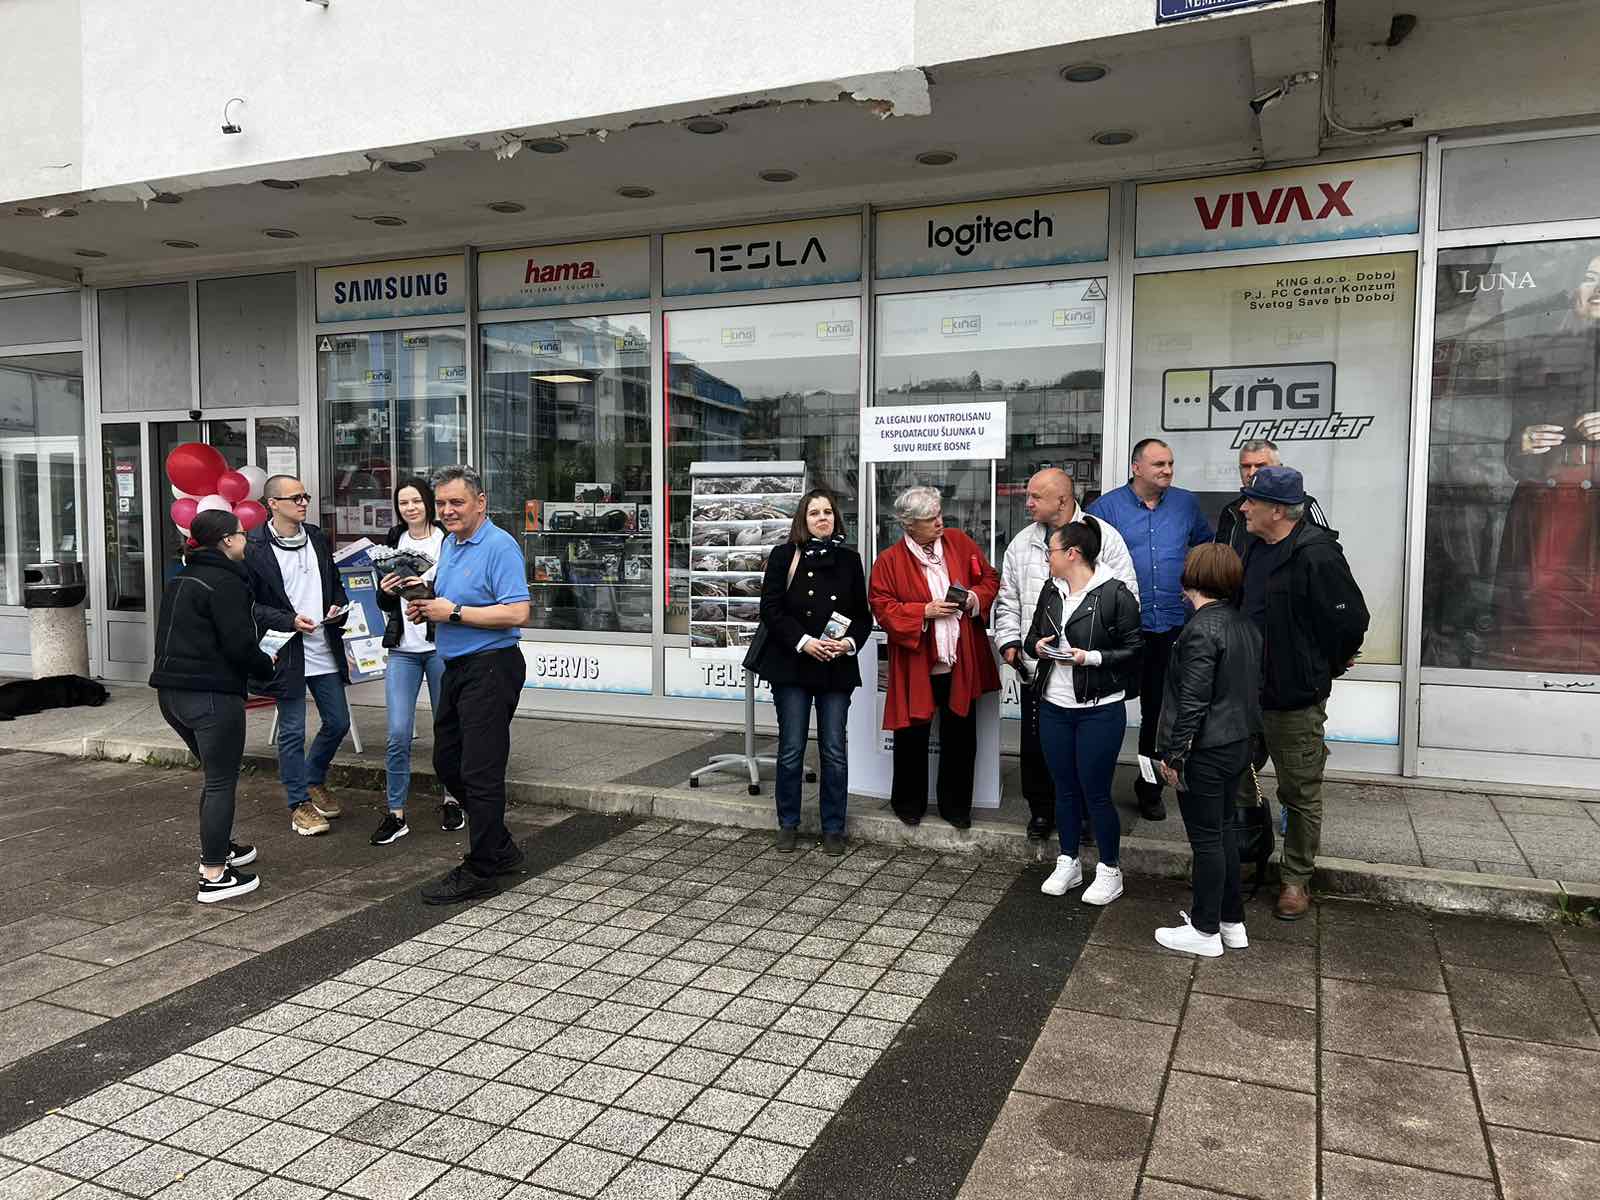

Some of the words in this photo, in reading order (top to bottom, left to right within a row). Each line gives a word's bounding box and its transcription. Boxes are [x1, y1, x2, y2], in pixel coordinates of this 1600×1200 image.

[1193, 179, 1354, 230] VIVAX
[928, 209, 1054, 256] logitech
[695, 237, 827, 272] TESLA
[525, 259, 595, 284] hama
[1276, 276, 1309, 288] KING
[1313, 274, 1350, 286] d.o.o.
[1356, 271, 1396, 281] Doboj
[334, 272, 448, 304] SAMSUNG
[1244, 290, 1266, 300] P.J.
[1271, 289, 1288, 298] PC
[1293, 285, 1337, 297] Centar
[1342, 282, 1395, 293] Konzum
[1249, 300, 1293, 310] Svetog
[1298, 297, 1329, 307] Save
[1334, 294, 1350, 304] bb
[1355, 292, 1395, 302] Doboj
[1209, 381, 1320, 412] KING
[875, 416, 885, 425] ZA
[886, 414, 922, 425] LEGALNU
[928, 412, 991, 423] KONTROLISANU
[880, 428, 939, 439] EKSPLOATACIJU
[941, 427, 977, 437] ŠLJUNKA
[978, 427, 985, 436] U
[893, 443, 916, 452] SLIVU
[918, 442, 942, 451] RIJEKE
[944, 441, 971, 451] BOSNE
[535, 653, 600, 680] SERVIS
